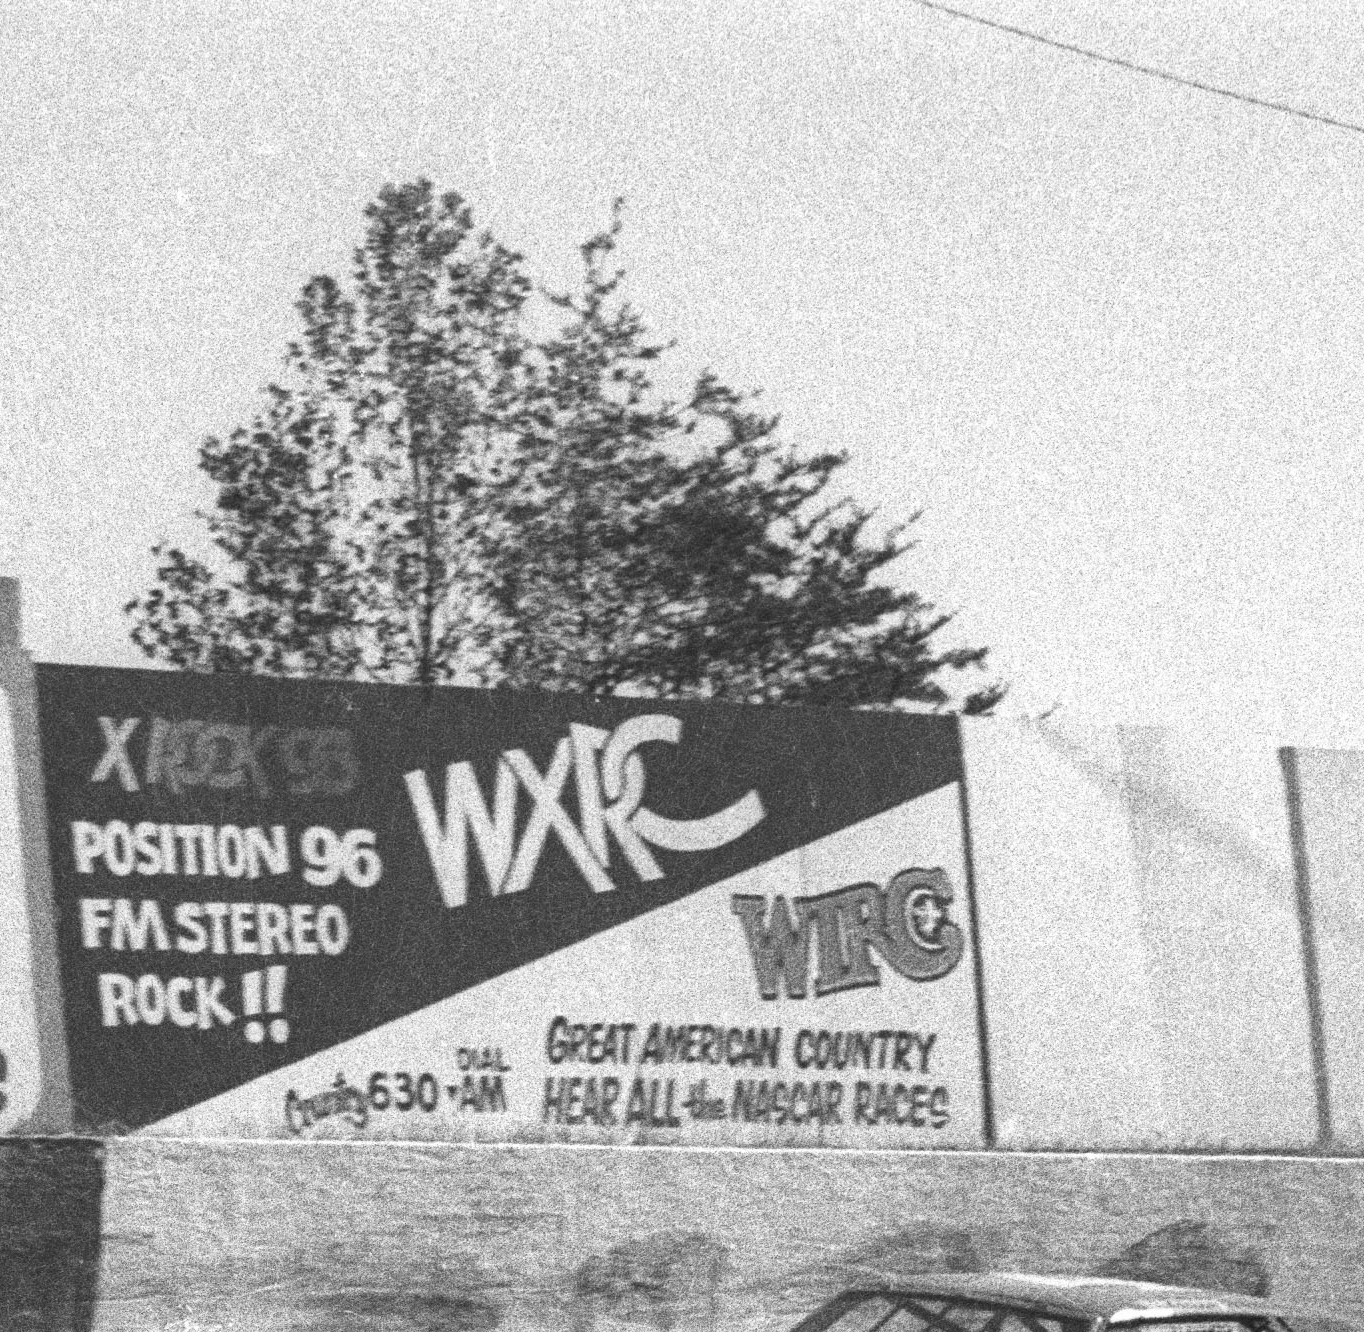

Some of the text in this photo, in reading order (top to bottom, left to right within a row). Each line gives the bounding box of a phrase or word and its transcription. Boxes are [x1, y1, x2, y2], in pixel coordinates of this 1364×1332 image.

[403, 713, 768, 908] WXRC
[71, 820, 383, 888] POSITION 96
[81, 898, 350, 956] FM STEREO
[97, 971, 236, 1030] ROCK
[546, 1014, 937, 1074] GREAT AMERICAN COUNTRY
[368, 1071, 439, 1114] 630
[543, 1076, 622, 1126] HEAR
[625, 1077, 681, 1129] ALL
[732, 1079, 844, 1127] NASCAR
[854, 1081, 950, 1130] RACES
